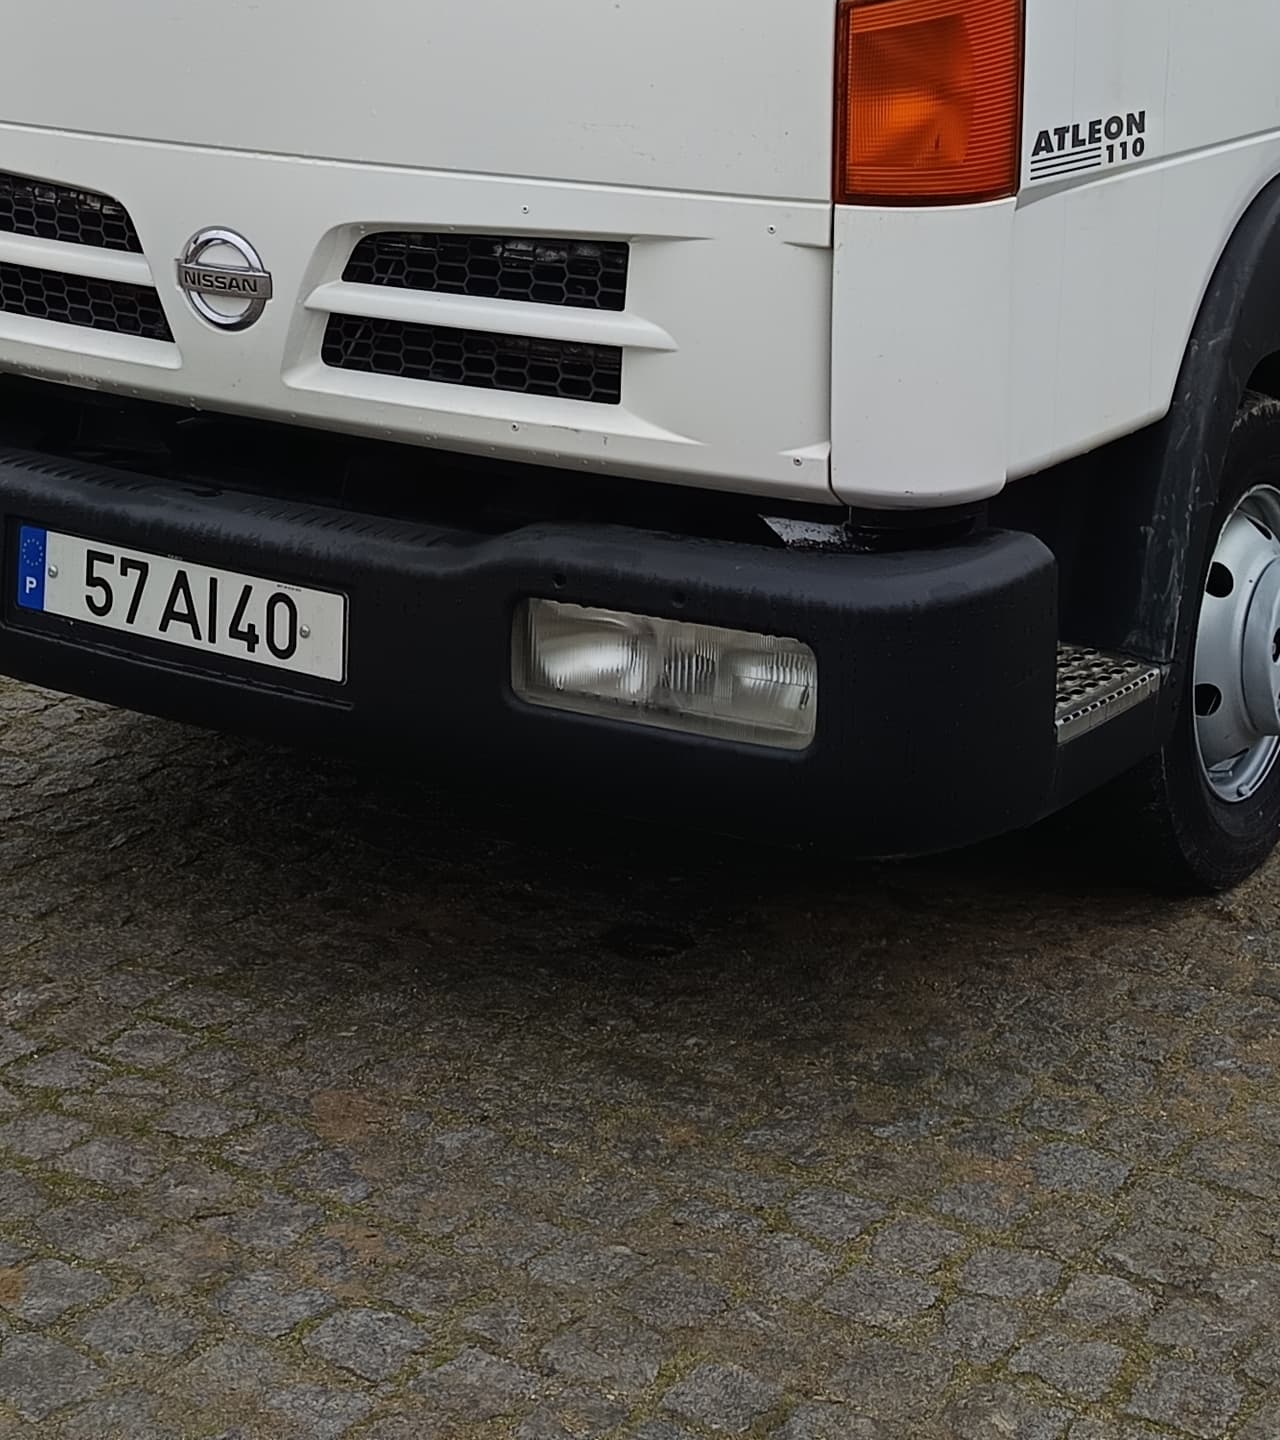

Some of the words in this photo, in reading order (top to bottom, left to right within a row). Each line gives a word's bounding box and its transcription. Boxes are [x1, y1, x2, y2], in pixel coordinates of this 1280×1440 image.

[1031, 110, 1146, 157] ATLEON
[1106, 137, 1145, 163] 110
[183, 270, 258, 293] NISSAN
[25, 577, 37, 594] P
